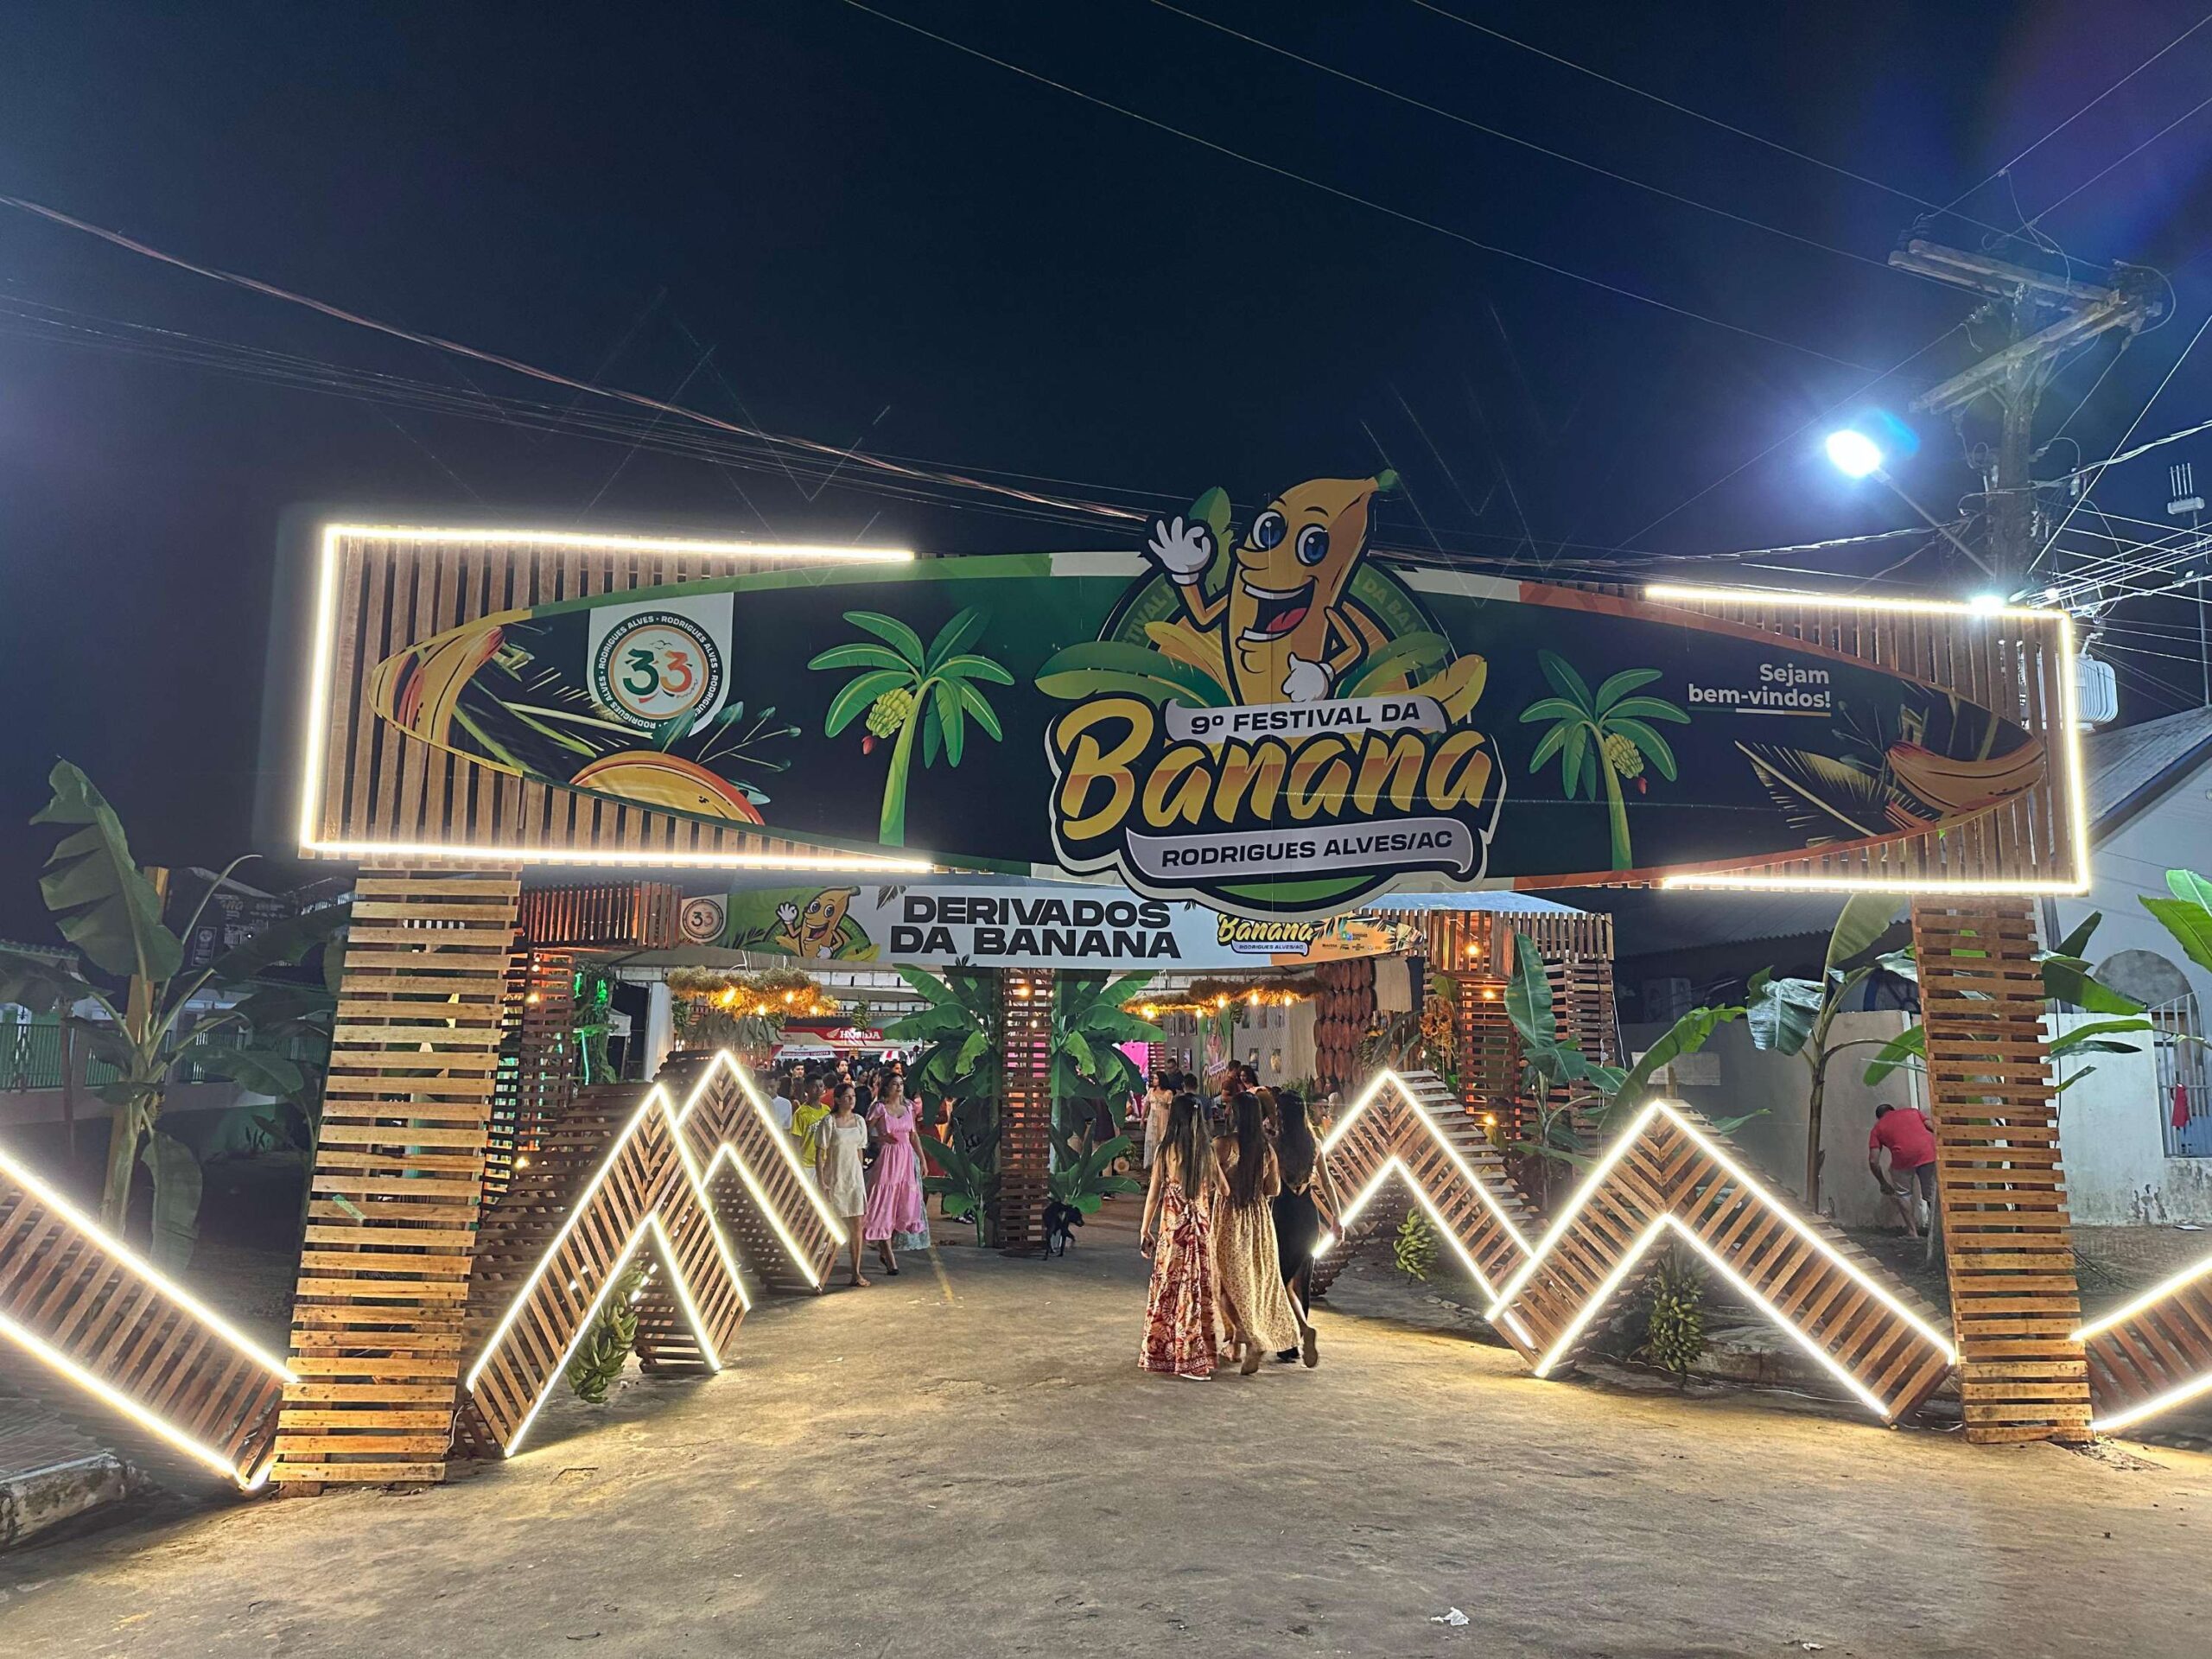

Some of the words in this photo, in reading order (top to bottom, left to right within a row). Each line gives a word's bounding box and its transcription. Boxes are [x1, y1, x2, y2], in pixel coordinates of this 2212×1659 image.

[598, 626, 627, 669] RODRIGUES
[627, 615, 654, 630] ALVES
[661, 615, 707, 644] RODRIGUES
[703, 643, 718, 669] ALVES
[598, 676, 613, 702] ALVES
[623, 649, 693, 696] 33
[1759, 663, 1829, 687] Sejam
[694, 675, 719, 716] RODRIGUE
[1688, 683, 1831, 709] bem-vindos!
[609, 701, 656, 729] RODRIGUES
[1191, 715, 1224, 735] 9º
[1233, 704, 1372, 733] FESTIVAL
[1381, 702, 1421, 723] DA
[1055, 697, 1493, 842] Banana
[1161, 842, 1316, 868] RODRIGUES
[1323, 830, 1453, 857] ALVES/AC
[691, 912, 714, 926] 33
[903, 895, 1171, 929] DERIVADOS
[1217, 912, 1314, 943] Banana
[890, 925, 958, 955] DA
[974, 927, 1182, 959] BANANA
